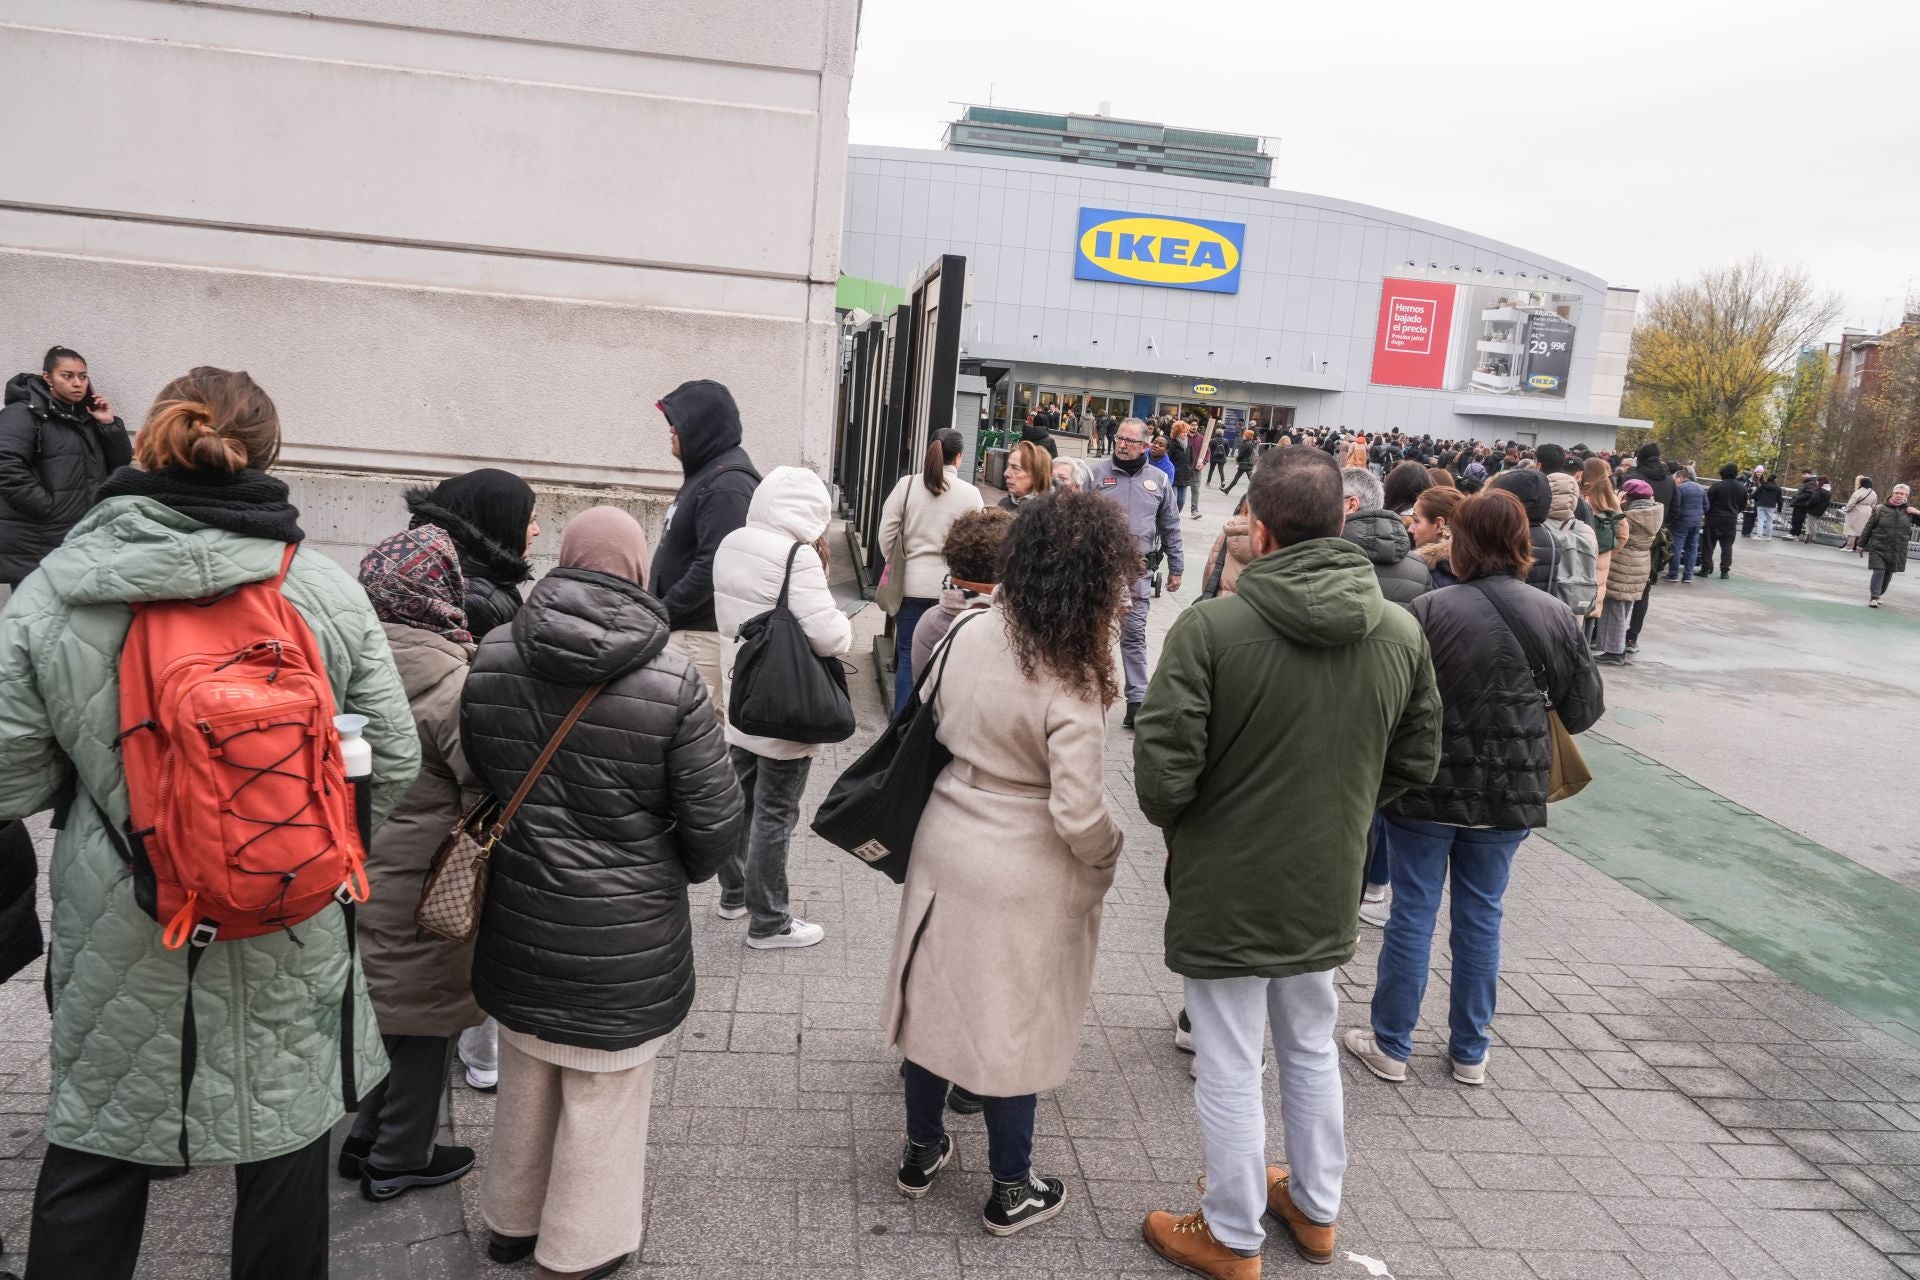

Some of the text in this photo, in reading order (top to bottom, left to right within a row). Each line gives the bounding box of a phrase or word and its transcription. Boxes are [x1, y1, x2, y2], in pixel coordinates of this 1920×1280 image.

[1094, 231, 1227, 270] IKEA
[1396, 304, 1424, 313] Hemos
[1394, 313, 1421, 323] bajado
[1393, 323, 1427, 333] el precio
[1530, 340, 1566, 356] 29,99€
